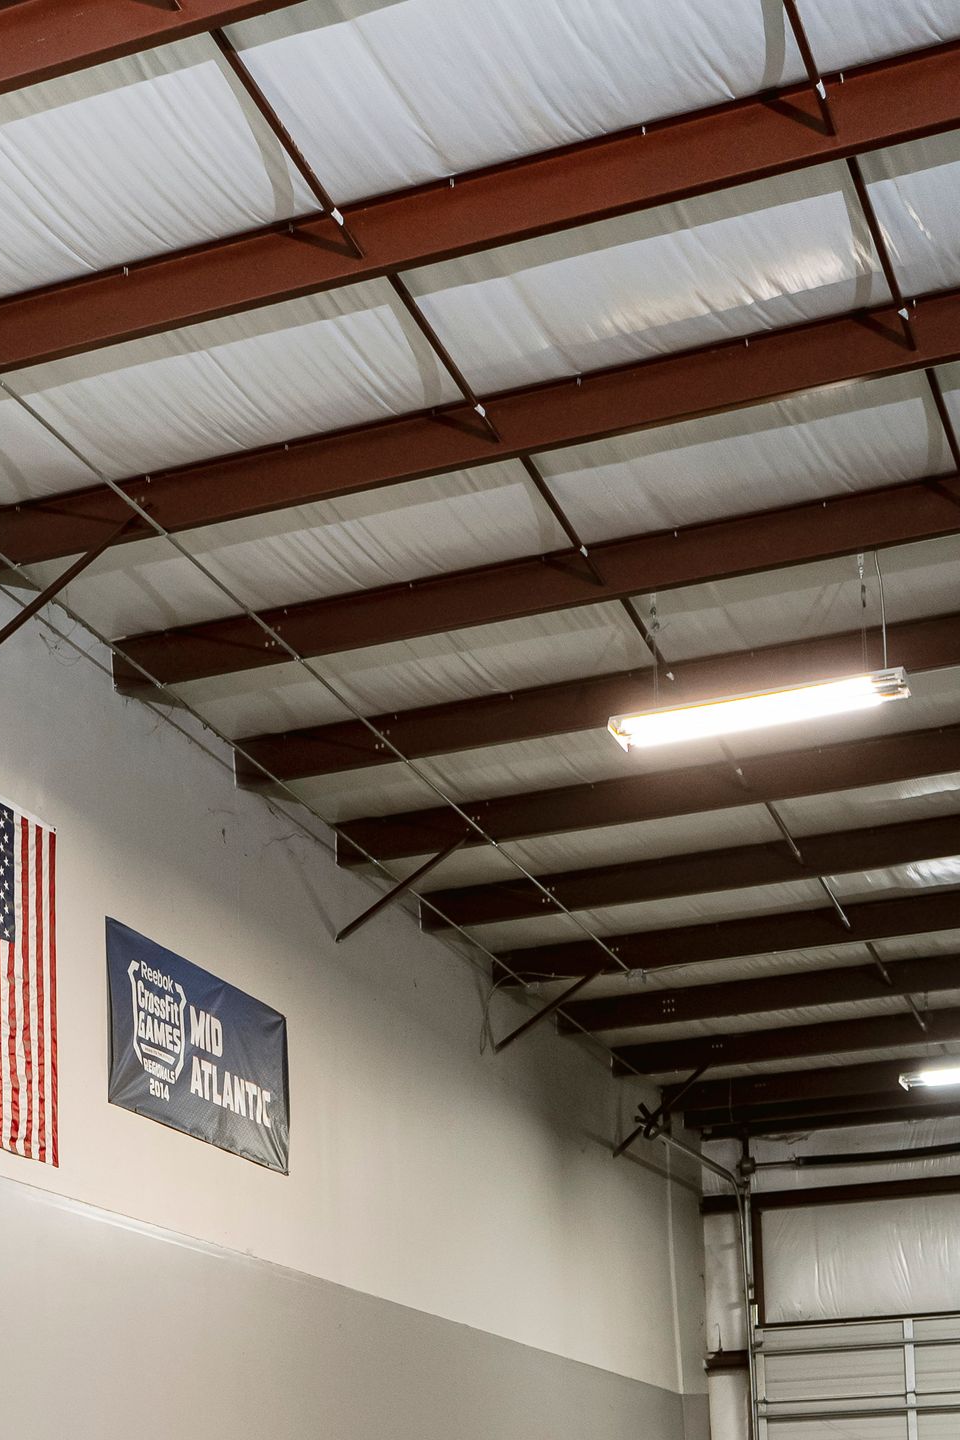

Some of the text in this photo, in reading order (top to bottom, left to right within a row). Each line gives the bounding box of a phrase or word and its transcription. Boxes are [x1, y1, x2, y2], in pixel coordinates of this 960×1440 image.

[140, 960, 174, 993] Reebok
[137, 979, 180, 1027] CrossFit
[138, 1010, 181, 1055] GAMES
[189, 1005, 223, 1058] MID
[142, 1057, 176, 1084] REGIONALS
[149, 1078, 170, 1101] 2014
[190, 1055, 272, 1128] ATLANTIC
